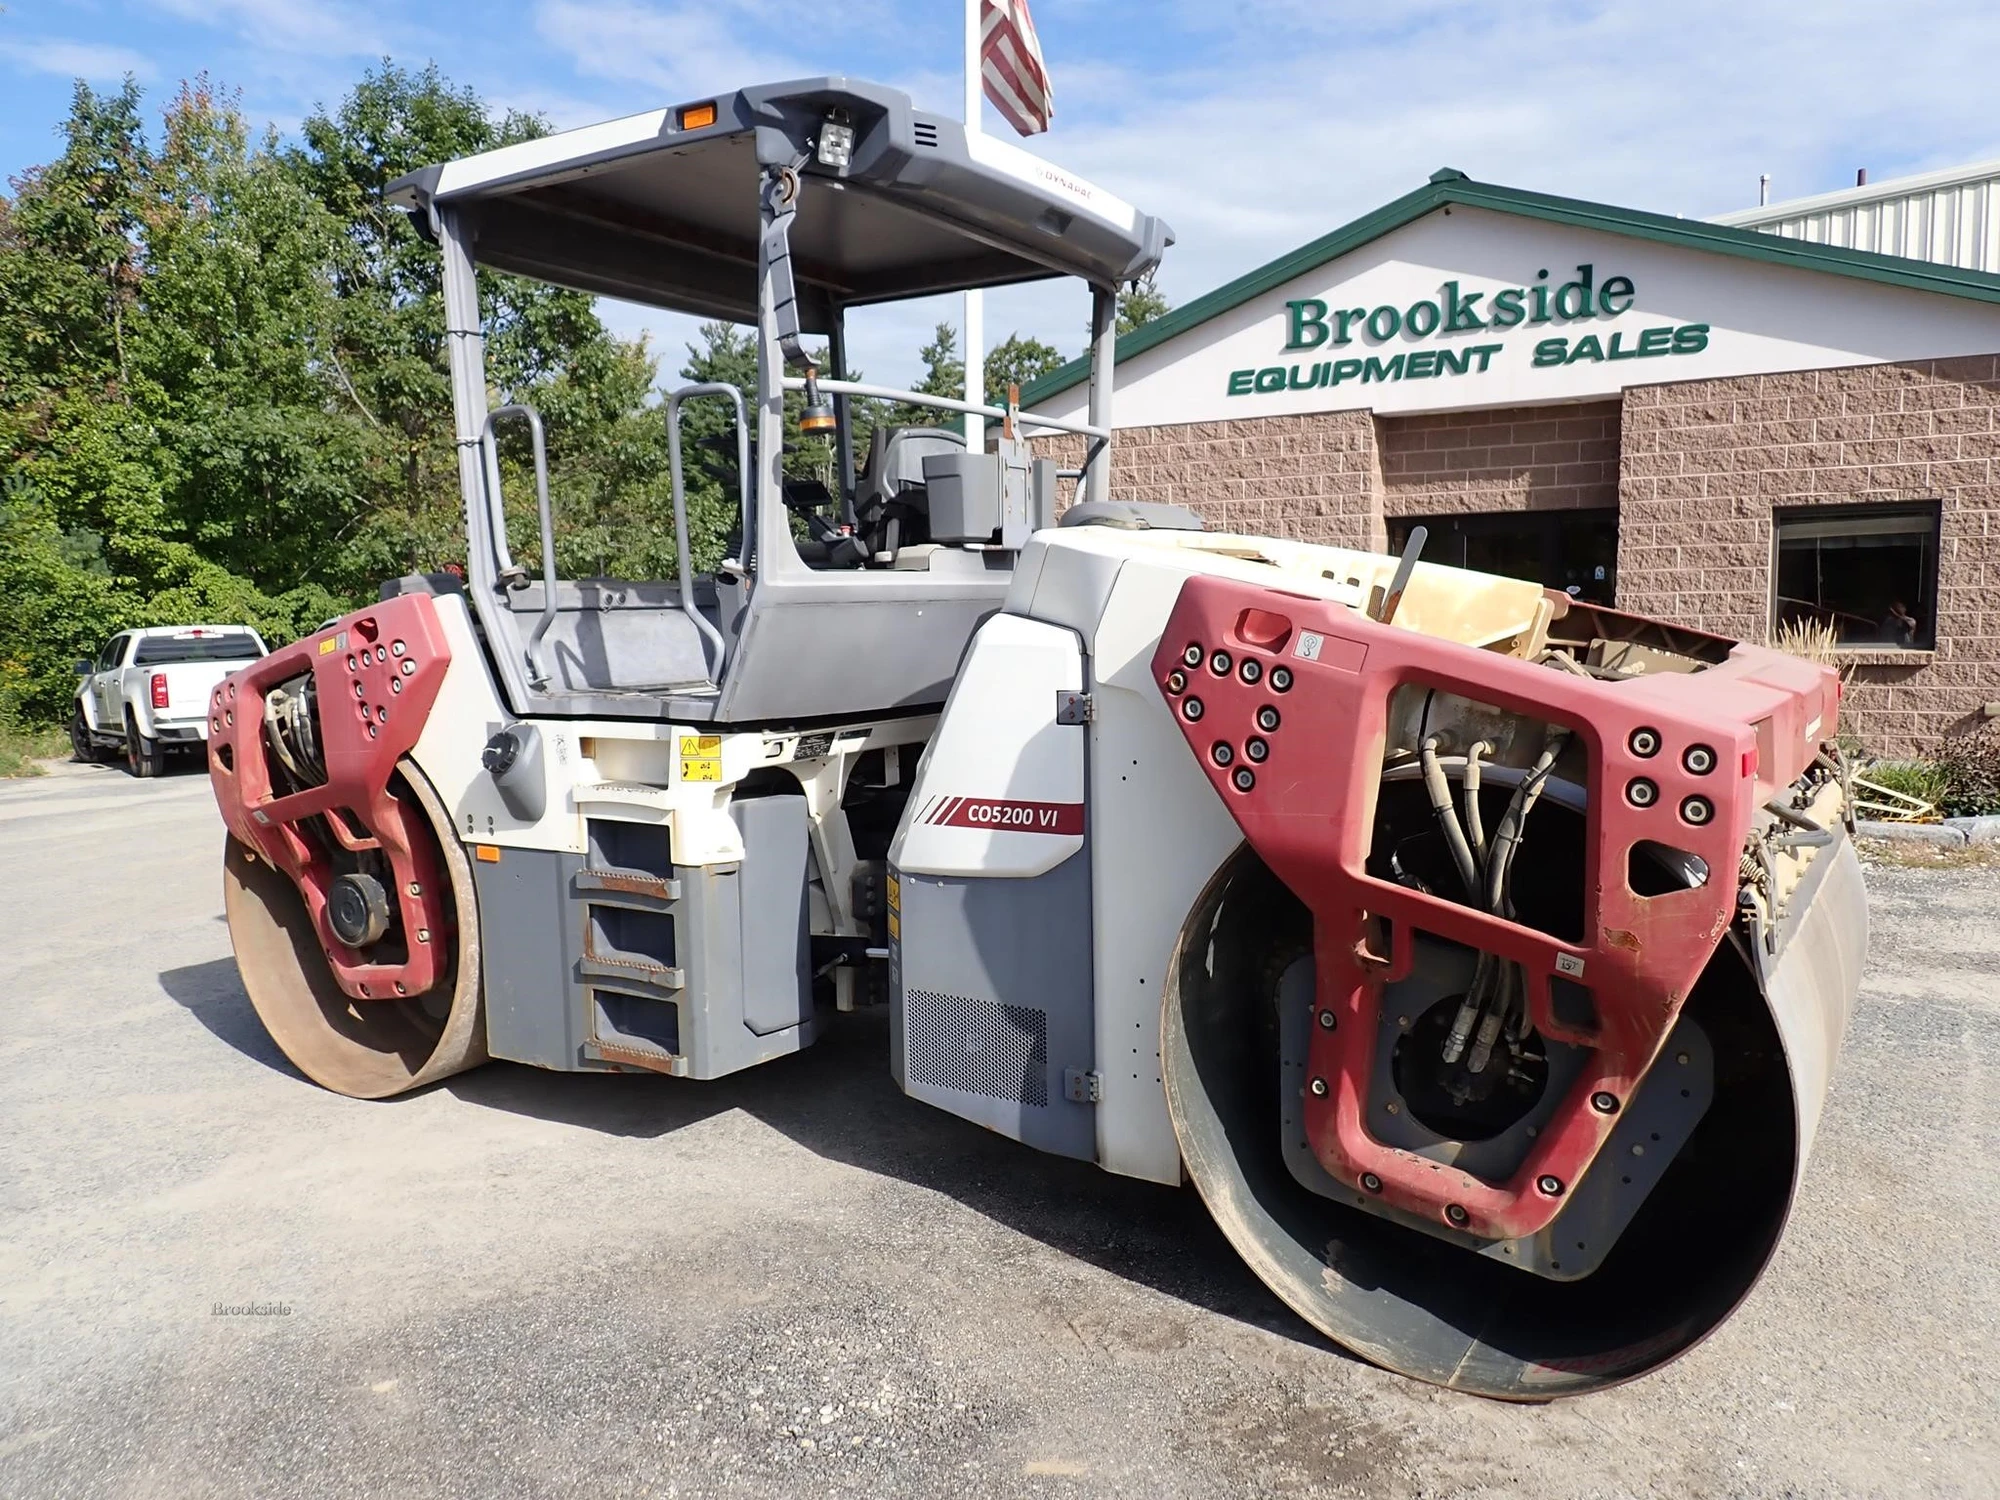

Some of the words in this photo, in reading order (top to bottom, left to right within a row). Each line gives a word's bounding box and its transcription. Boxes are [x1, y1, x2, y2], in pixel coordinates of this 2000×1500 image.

[1045, 171, 1092, 200] DYNAPAC
[1284, 263, 1636, 350] Brookside
[1227, 343, 1504, 396] EQUIPMENT
[1532, 323, 1711, 368] SALES
[967, 804, 1034, 826] CO5200
[1039, 809, 1058, 828] VI
